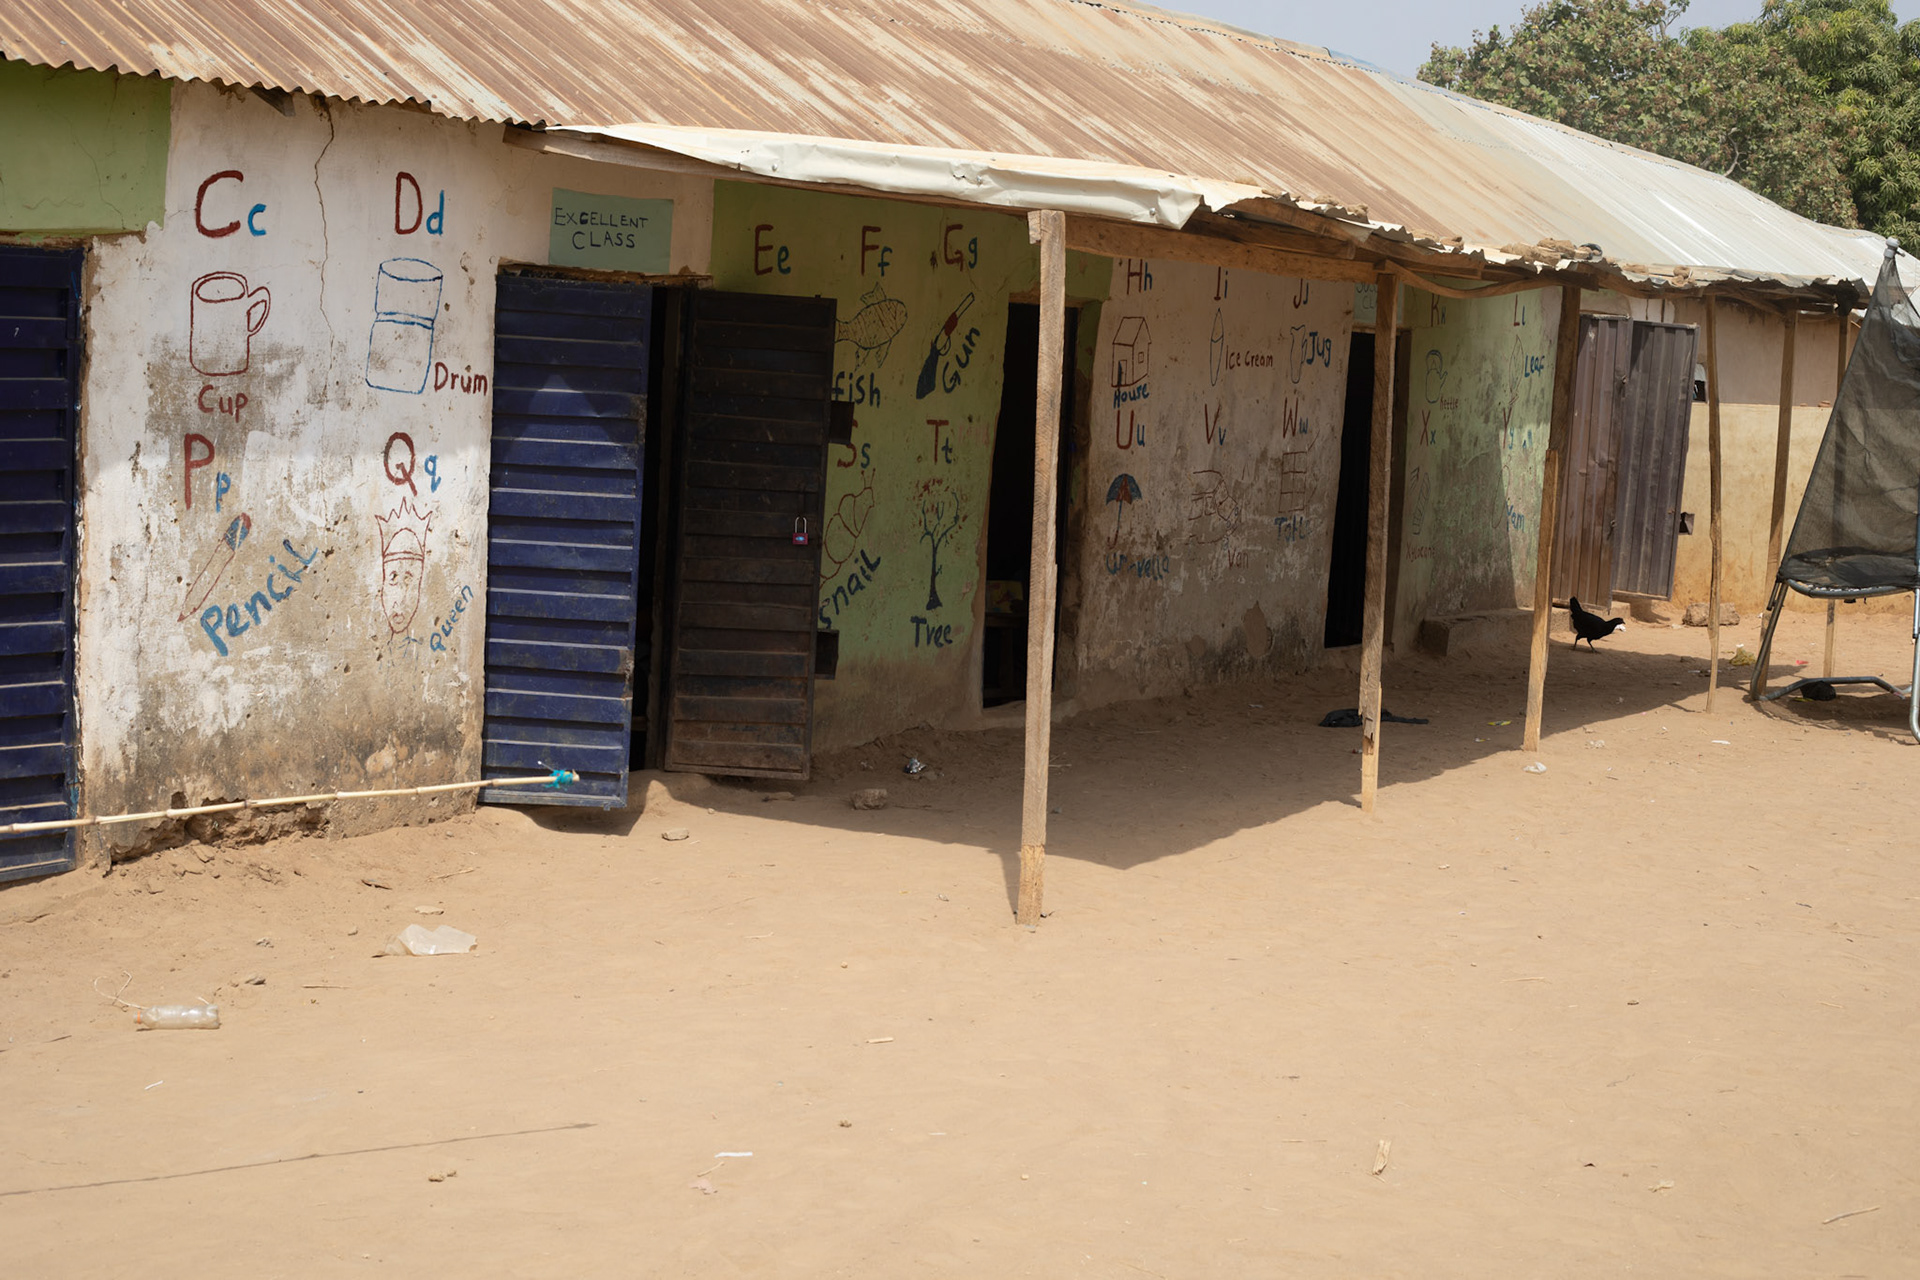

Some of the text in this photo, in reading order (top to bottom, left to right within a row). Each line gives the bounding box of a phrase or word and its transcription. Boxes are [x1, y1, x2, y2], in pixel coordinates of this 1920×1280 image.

[394, 171, 445, 235] Dd
[554, 207, 649, 229] EXCELLENT
[571, 231, 636, 250] CLASS
[942, 327, 981, 395] Gun
[1306, 331, 1333, 368] Jug
[434, 362, 488, 396] Drum
[199, 384, 248, 422] Cup
[910, 616, 953, 648] Tree
